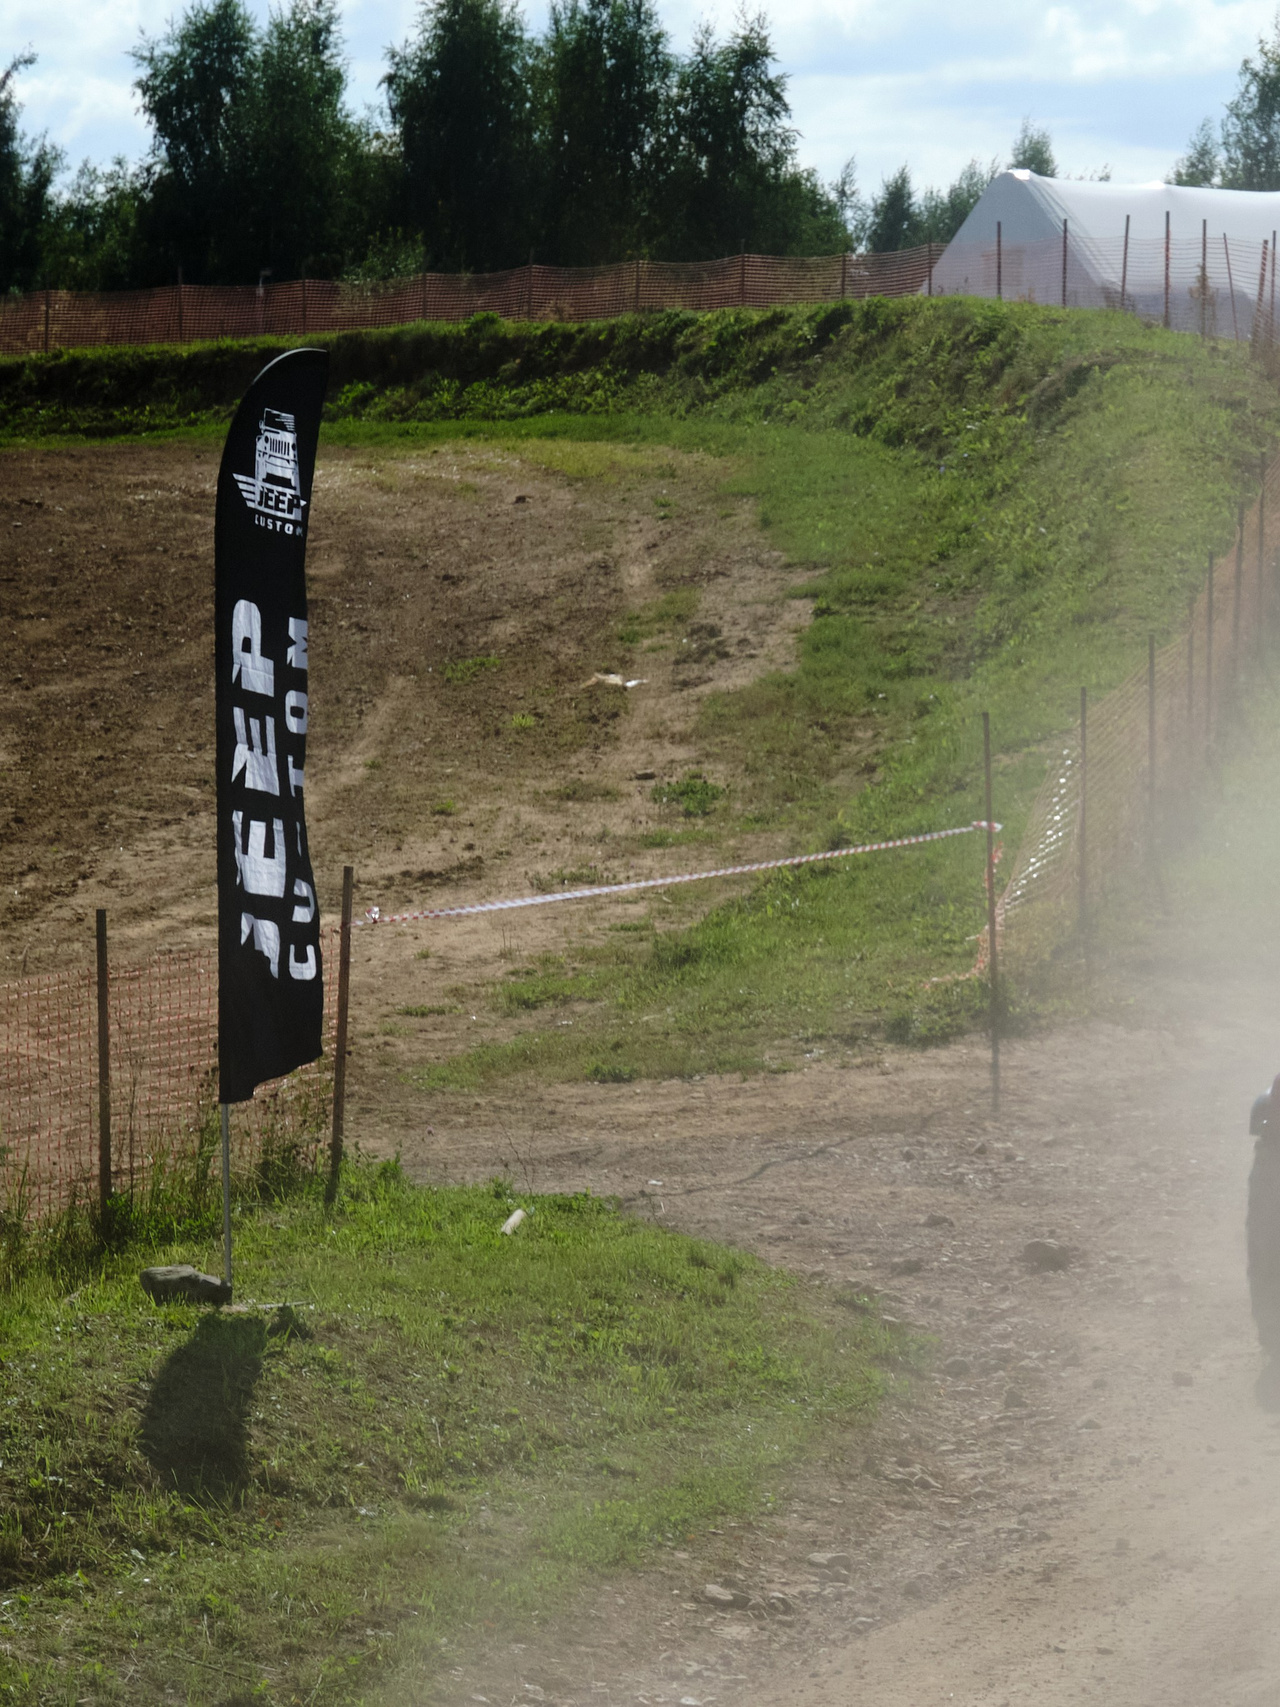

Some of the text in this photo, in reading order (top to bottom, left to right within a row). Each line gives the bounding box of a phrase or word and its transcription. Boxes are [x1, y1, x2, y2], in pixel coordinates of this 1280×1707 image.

[256, 486, 301, 517] JEEP
[231, 598, 286, 980] JEEP
[285, 616, 317, 982] CUTOM
